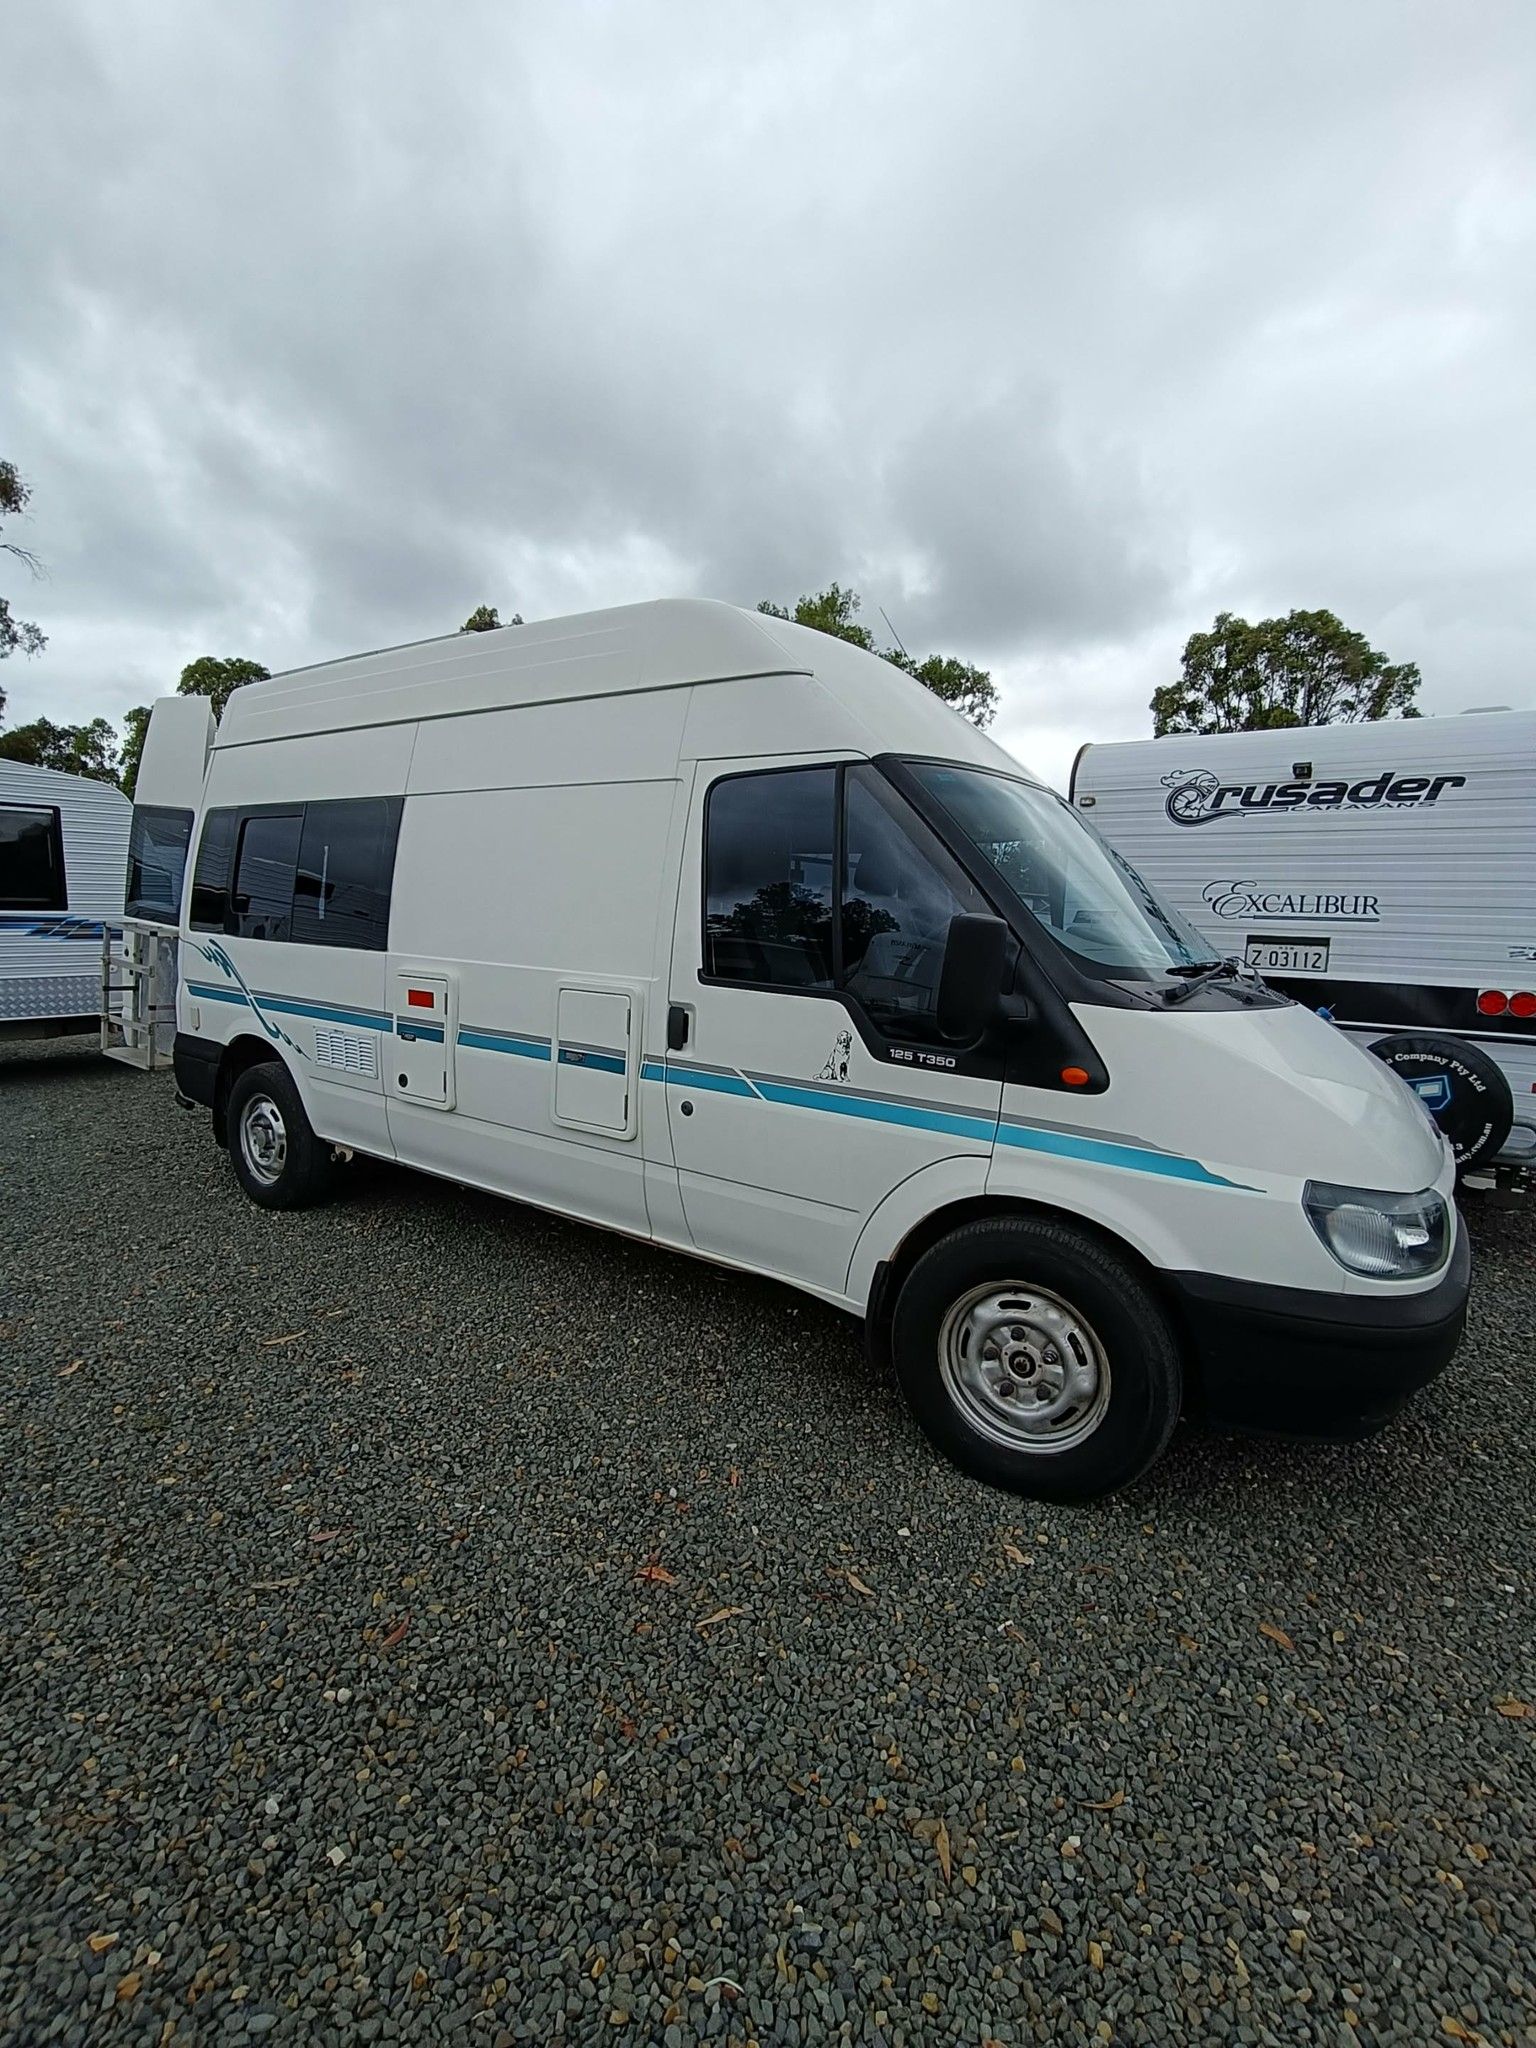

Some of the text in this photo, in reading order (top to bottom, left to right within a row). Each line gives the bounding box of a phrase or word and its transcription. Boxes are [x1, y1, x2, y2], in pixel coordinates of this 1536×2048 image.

[1161, 769, 1467, 827] Crusader
[1288, 802, 1435, 812] CARAVANS
[890, 1049, 956, 1067] 125 T350
[1395, 1053, 1449, 1065] Company
[1449, 1060, 1470, 1076] Pty
[1468, 1074, 1487, 1092] Ltd
